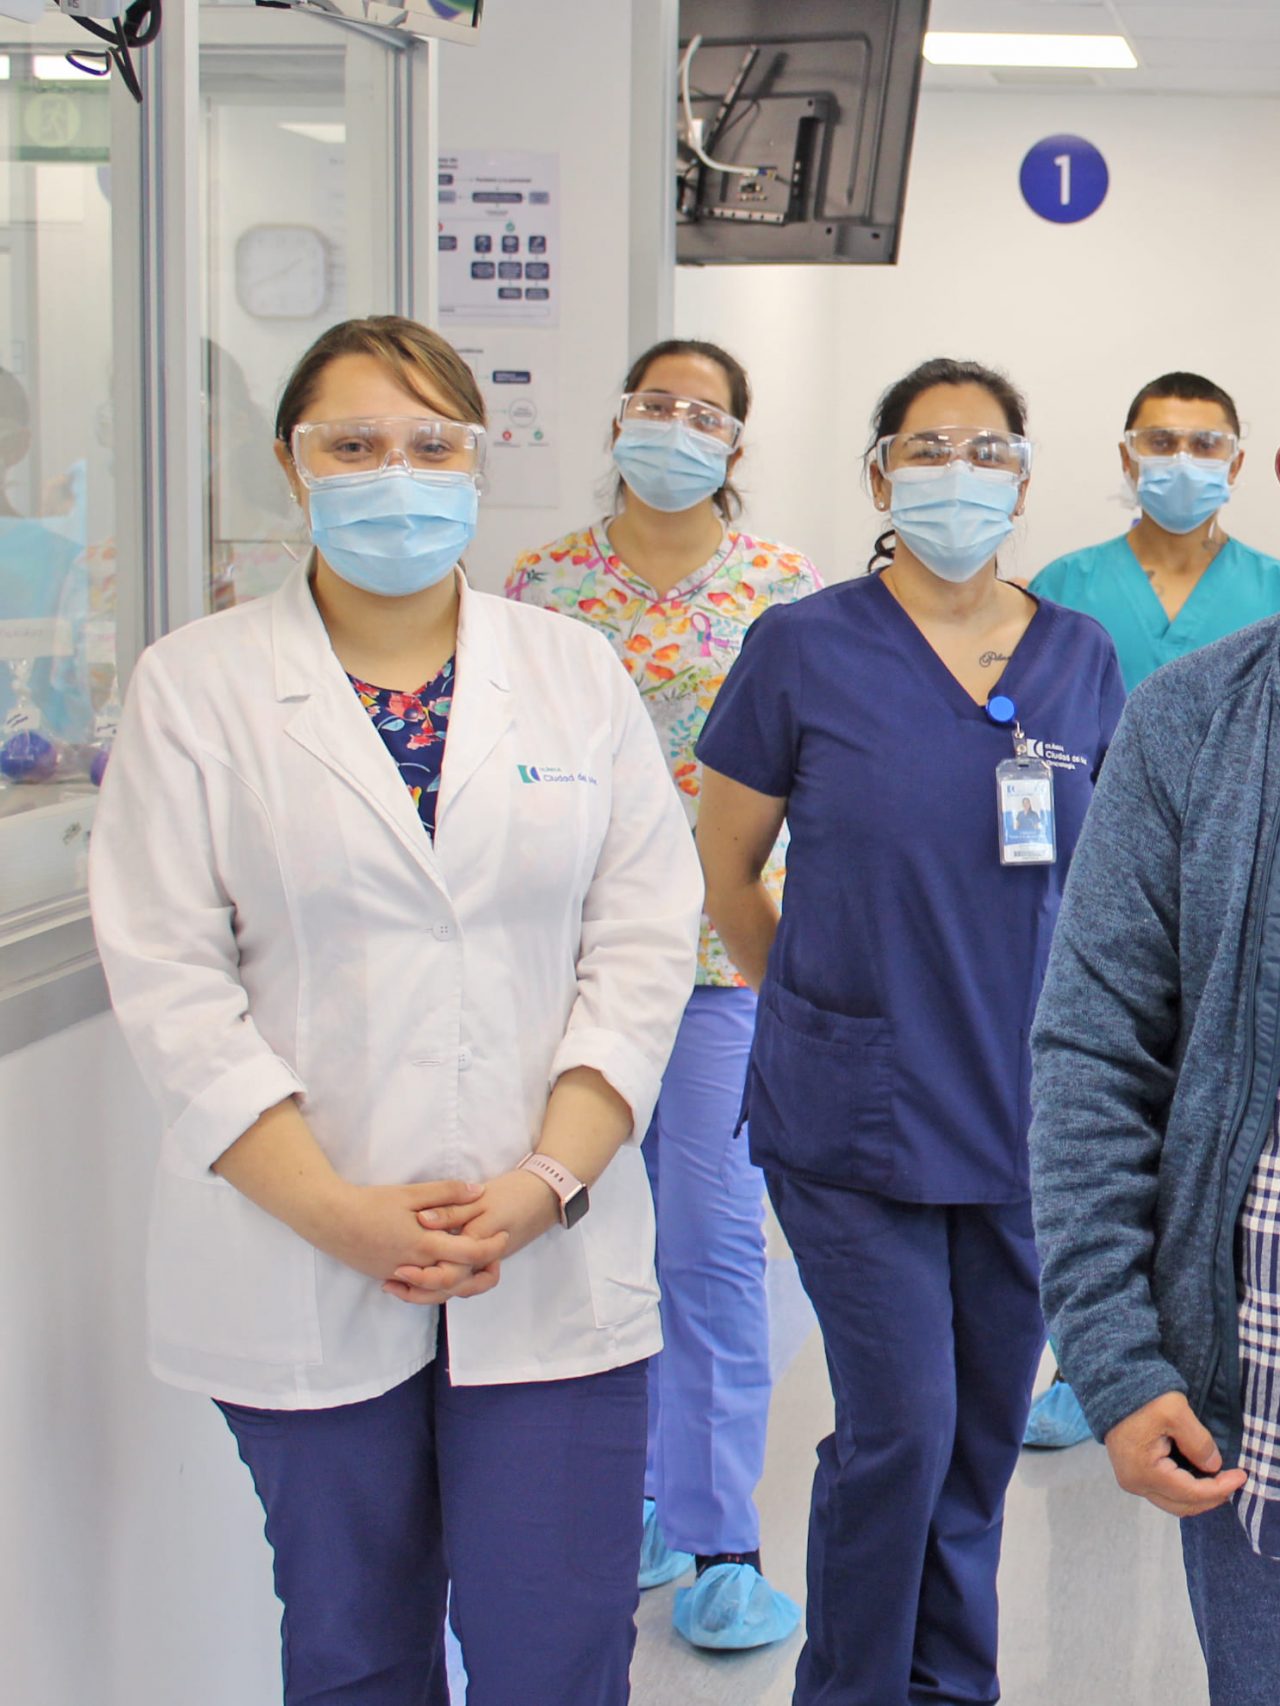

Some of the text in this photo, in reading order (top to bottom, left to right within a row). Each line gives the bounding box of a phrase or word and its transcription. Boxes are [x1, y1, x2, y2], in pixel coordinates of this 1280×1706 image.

[1053, 153, 1071, 206] 1
[1045, 751, 1071, 762] Ciudad
[543, 773, 575, 782] Ciudad
